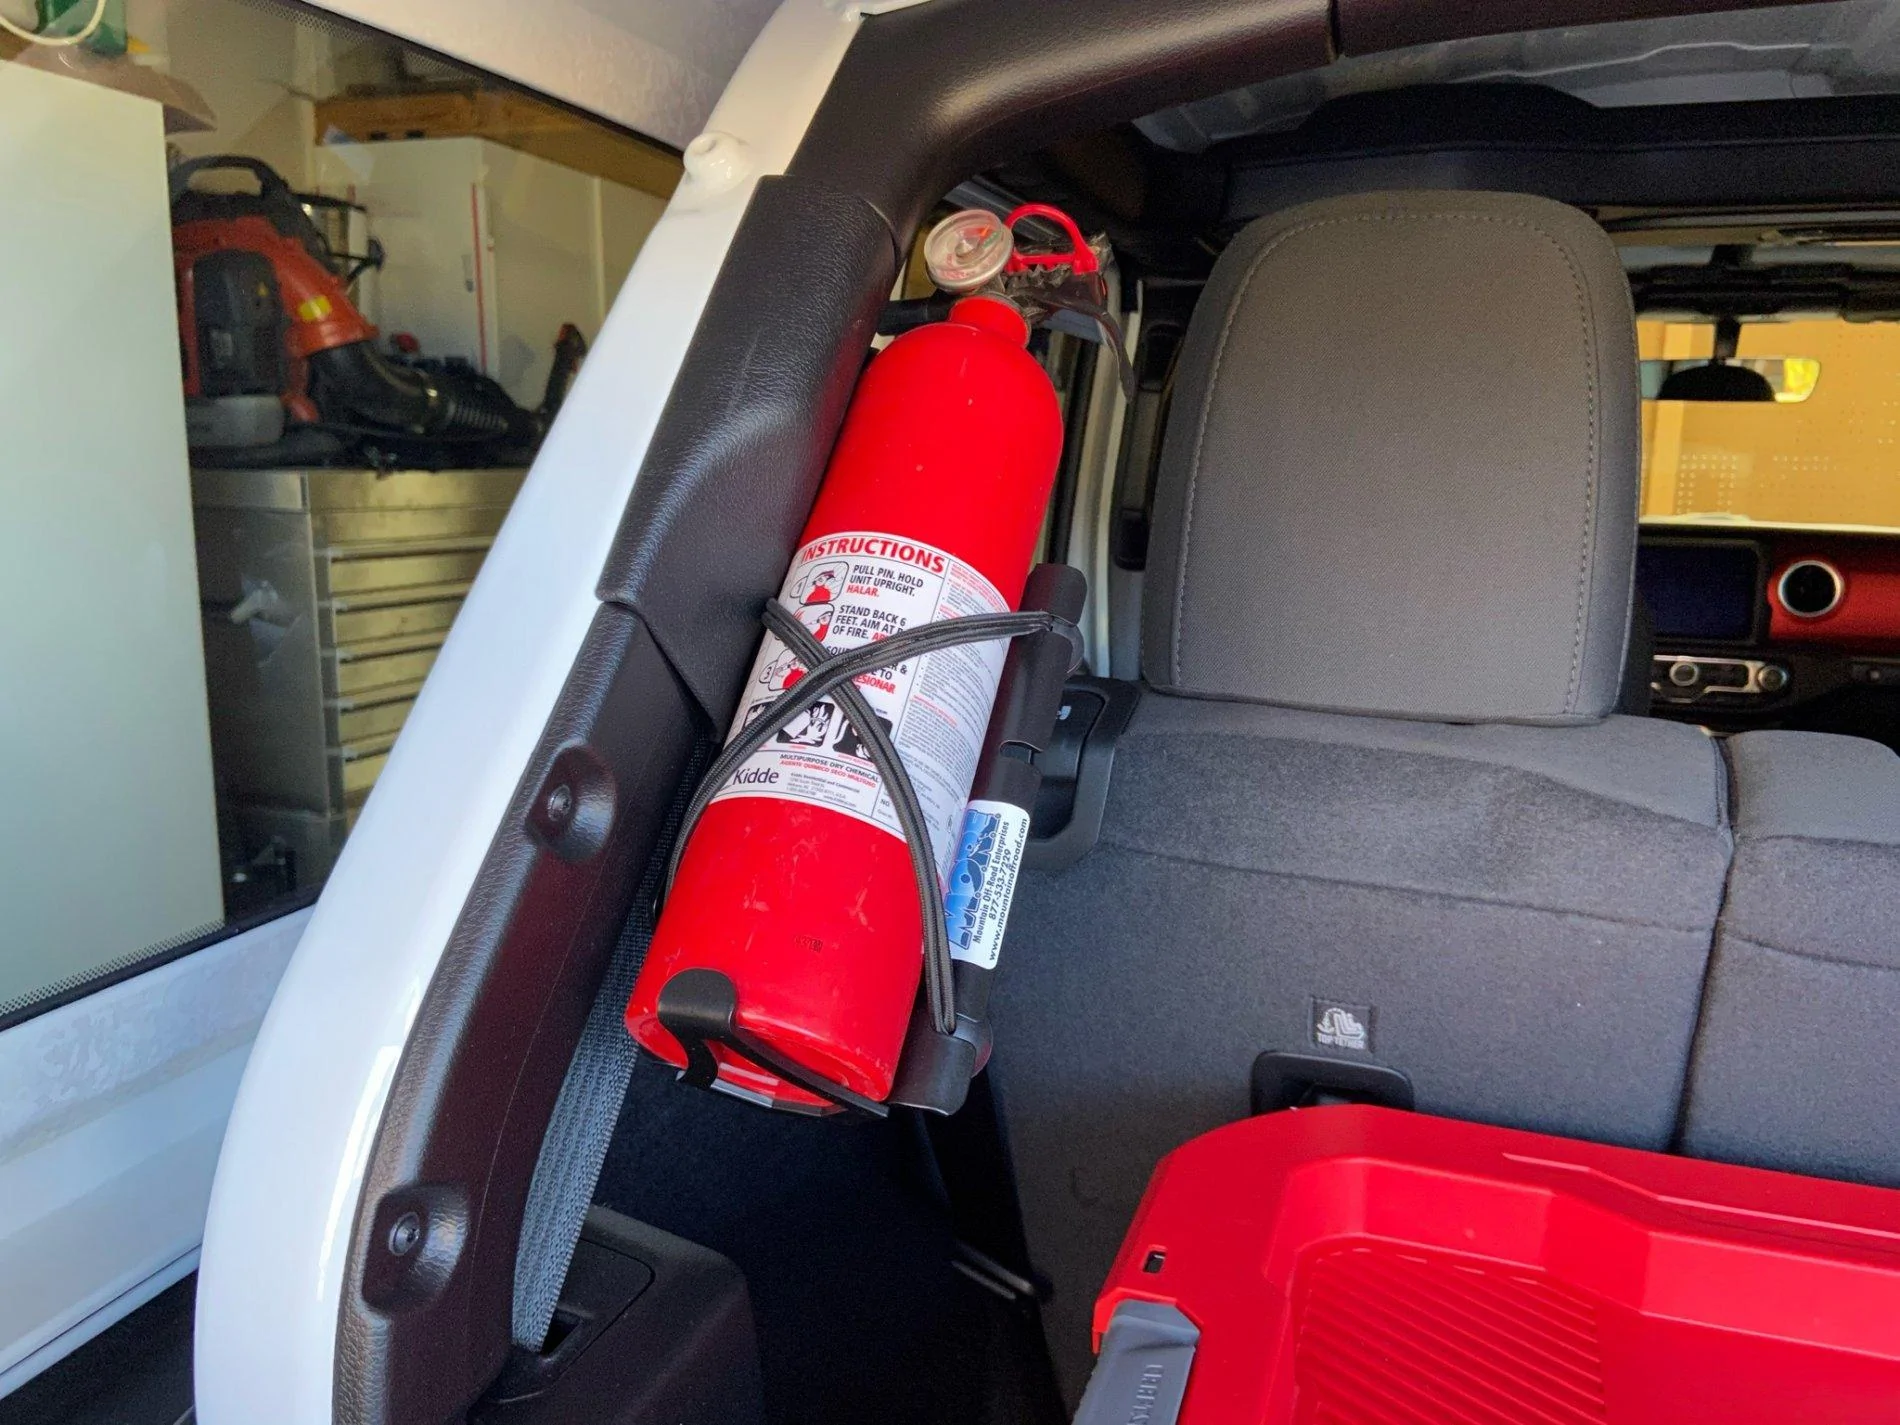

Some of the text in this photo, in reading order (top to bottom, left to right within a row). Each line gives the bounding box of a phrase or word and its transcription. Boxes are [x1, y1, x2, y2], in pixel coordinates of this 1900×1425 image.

[803, 537, 944, 574] INSTRUCTIONS
[849, 574, 915, 597] UNIT UPRIGHT.
[853, 564, 924, 588] PULL PIN. HOLD
[846, 584, 880, 598] HALAR.
[835, 615, 859, 629] FEET.
[860, 618, 880, 632] AIM
[881, 622, 896, 635] AT
[838, 604, 907, 627] STAND BACK 6
[832, 625, 845, 636] OF
[846, 626, 869, 640] FIRE.
[880, 668, 893, 680] TO
[900, 664, 908, 675] &
[733, 768, 779, 785] Kidde
[780, 753, 828, 766] MULTIPURPOSE
[829, 761, 845, 770] DRY
[845, 766, 878, 783] CHEMICAL
[973, 821, 1009, 944] Mountain Off-Road Enterprises
[988, 849, 1012, 920] 877-533-7229
[989, 818, 1028, 961] www.mountainoffroad.com
